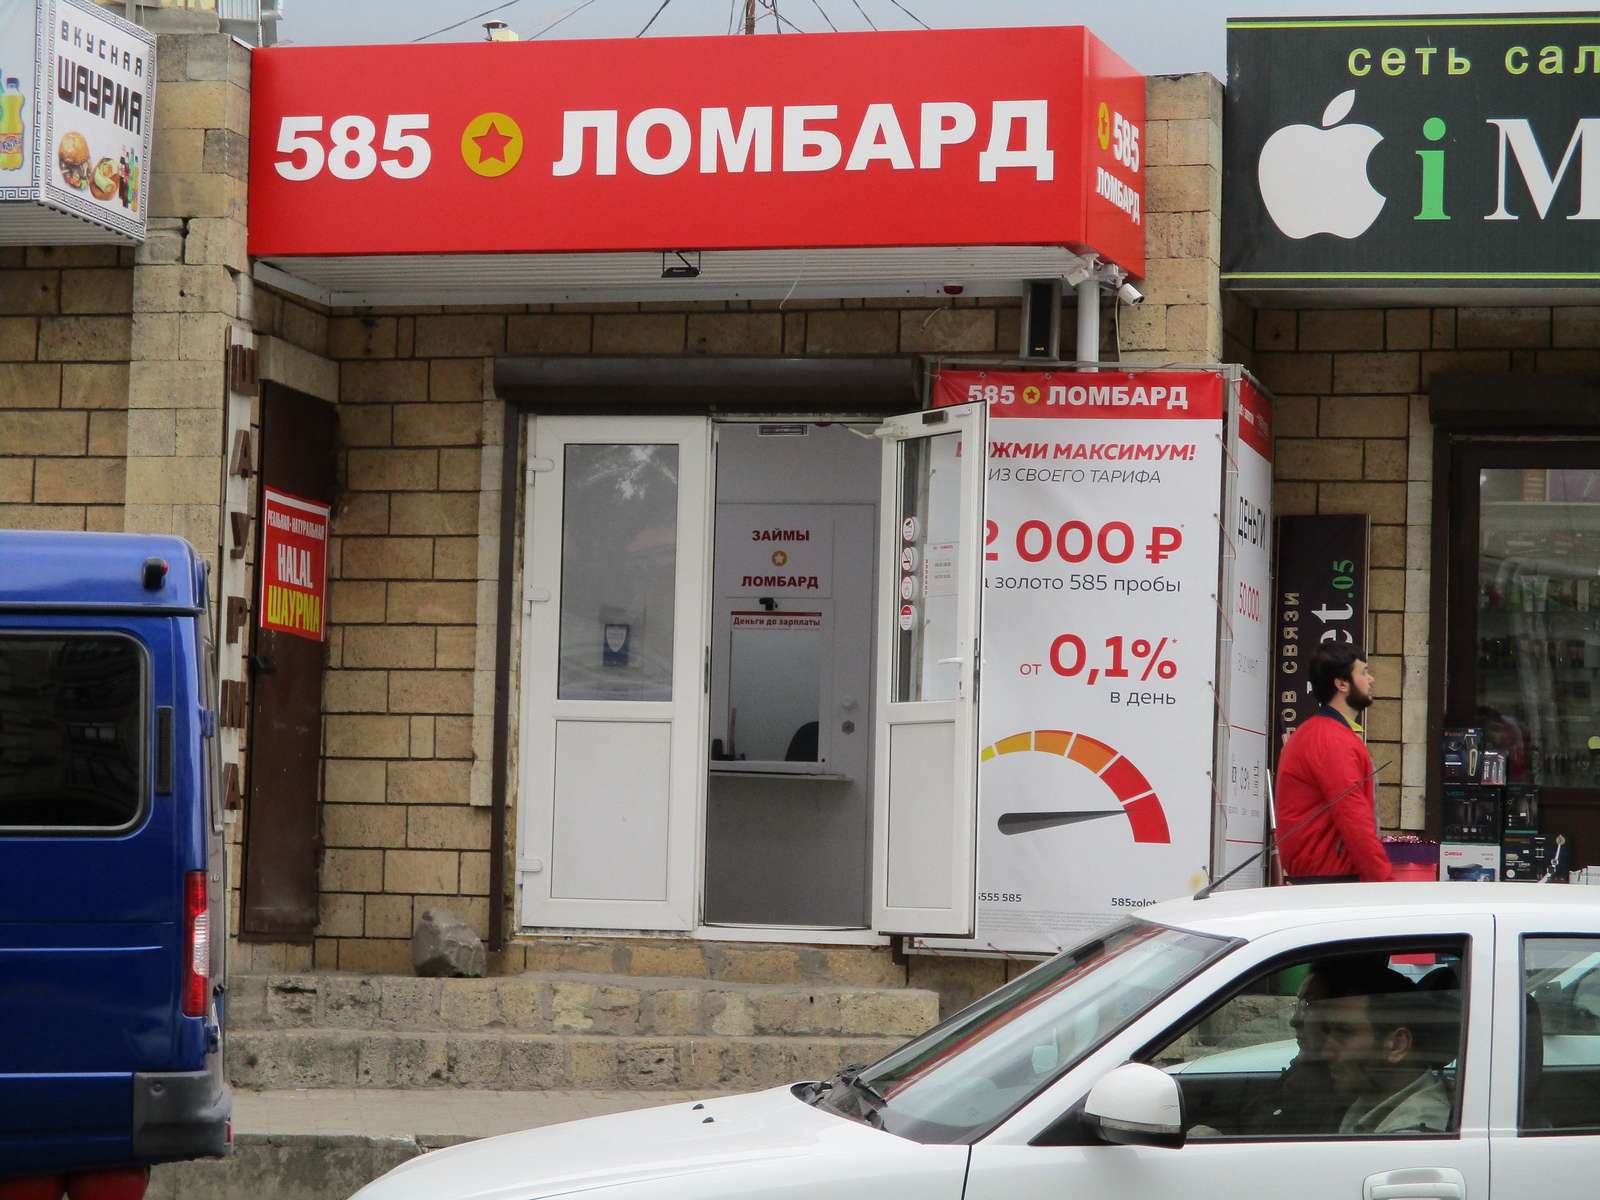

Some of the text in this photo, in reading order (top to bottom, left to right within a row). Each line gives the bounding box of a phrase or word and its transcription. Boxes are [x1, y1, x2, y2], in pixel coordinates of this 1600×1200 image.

[61, 20, 143, 78] ВКУСНАЯ
[1348, 45, 1600, 76] сеть сал
[58, 55, 142, 135] ШАУРМА
[274, 99, 1054, 183] 585 ЛОМБАРД
[1112, 111, 1139, 173] 585
[1096, 166, 1140, 225] ЛОМБАРД
[967, 384, 1188, 410] 585 ЛОМБАРД
[1053, 442, 1196, 461] МАКСИМУМ!
[988, 468, 1161, 484] ИЗ СВОЕГО ТАРИФА
[752, 528, 810, 542] ЗАЙМЫ
[1016, 519, 1135, 564] 000
[277, 543, 314, 589] HALAL
[741, 575, 819, 589] ЛОМБАРД
[995, 576, 1064, 590] золото
[1070, 574, 1107, 591] 585
[1114, 575, 1180, 595] пробы
[267, 584, 321, 633] ШАУРМА
[733, 616, 821, 628] Деньги до зарплаты
[1282, 592, 1300, 674] СВЯЗИ
[1019, 663, 1042, 676] от
[1110, 691, 1176, 707] в день
[978, 892, 1022, 903] 555 585
